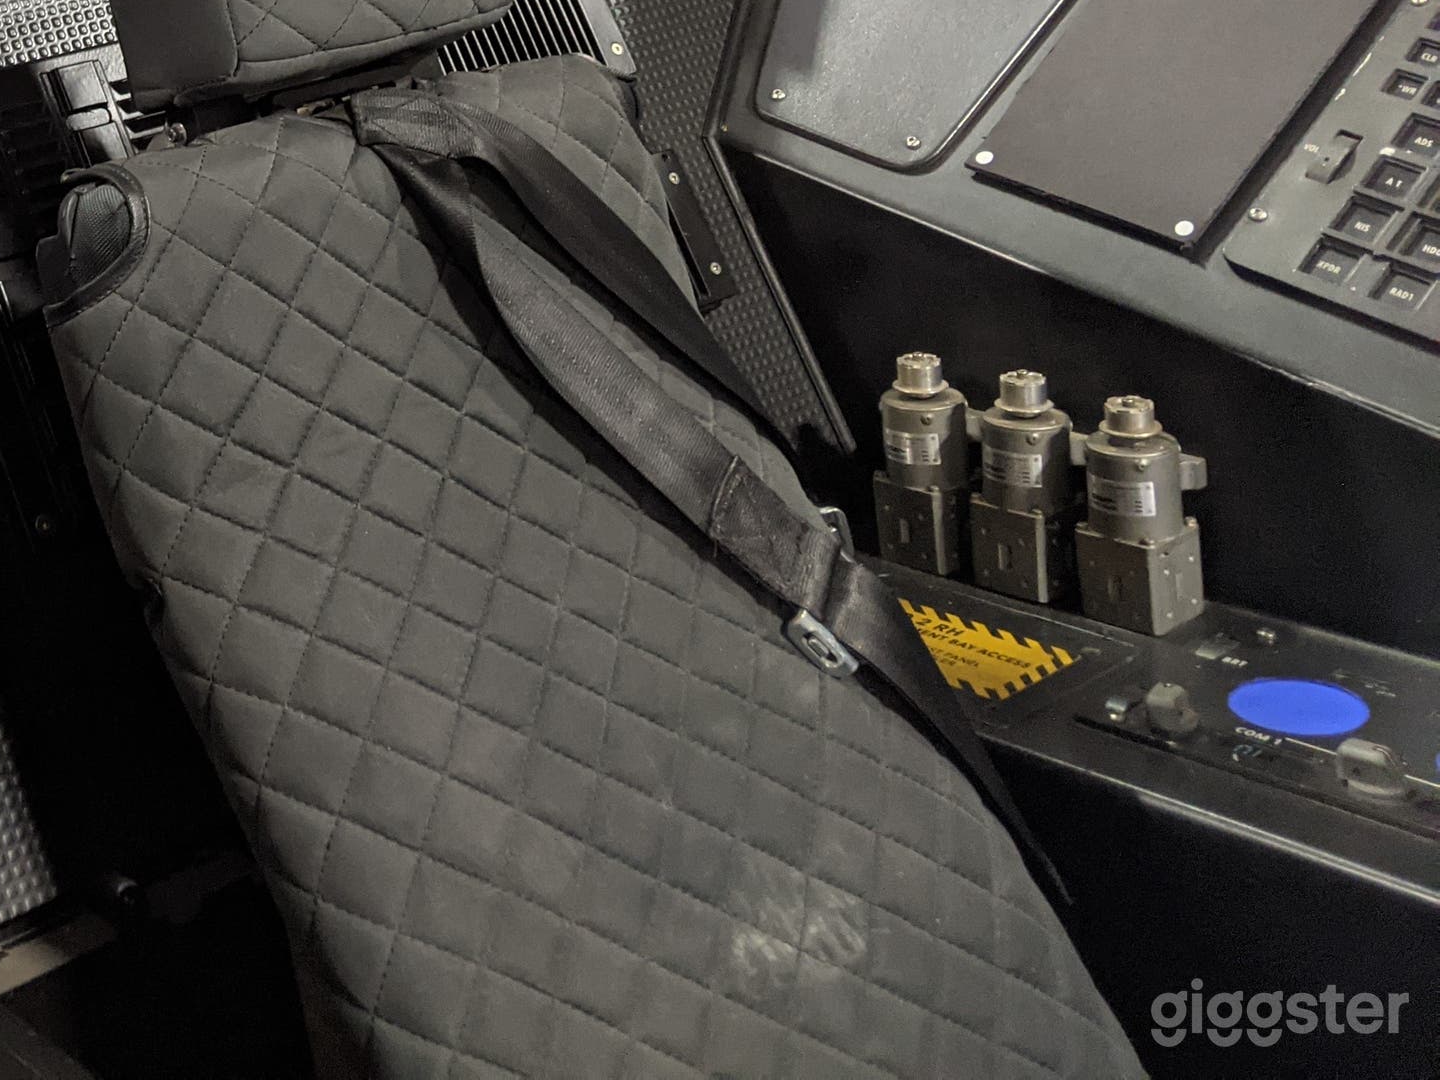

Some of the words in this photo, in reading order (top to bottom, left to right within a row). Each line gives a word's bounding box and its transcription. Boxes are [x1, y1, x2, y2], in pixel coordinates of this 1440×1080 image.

[1388, 286, 1415, 300] RAD1
[933, 623, 965, 637] RH
[918, 628, 949, 640] ENT
[948, 638, 975, 650] BAY
[976, 648, 1031, 669] ACCESS
[943, 652, 980, 668] PANEL
[1234, 726, 1271, 742] COM
